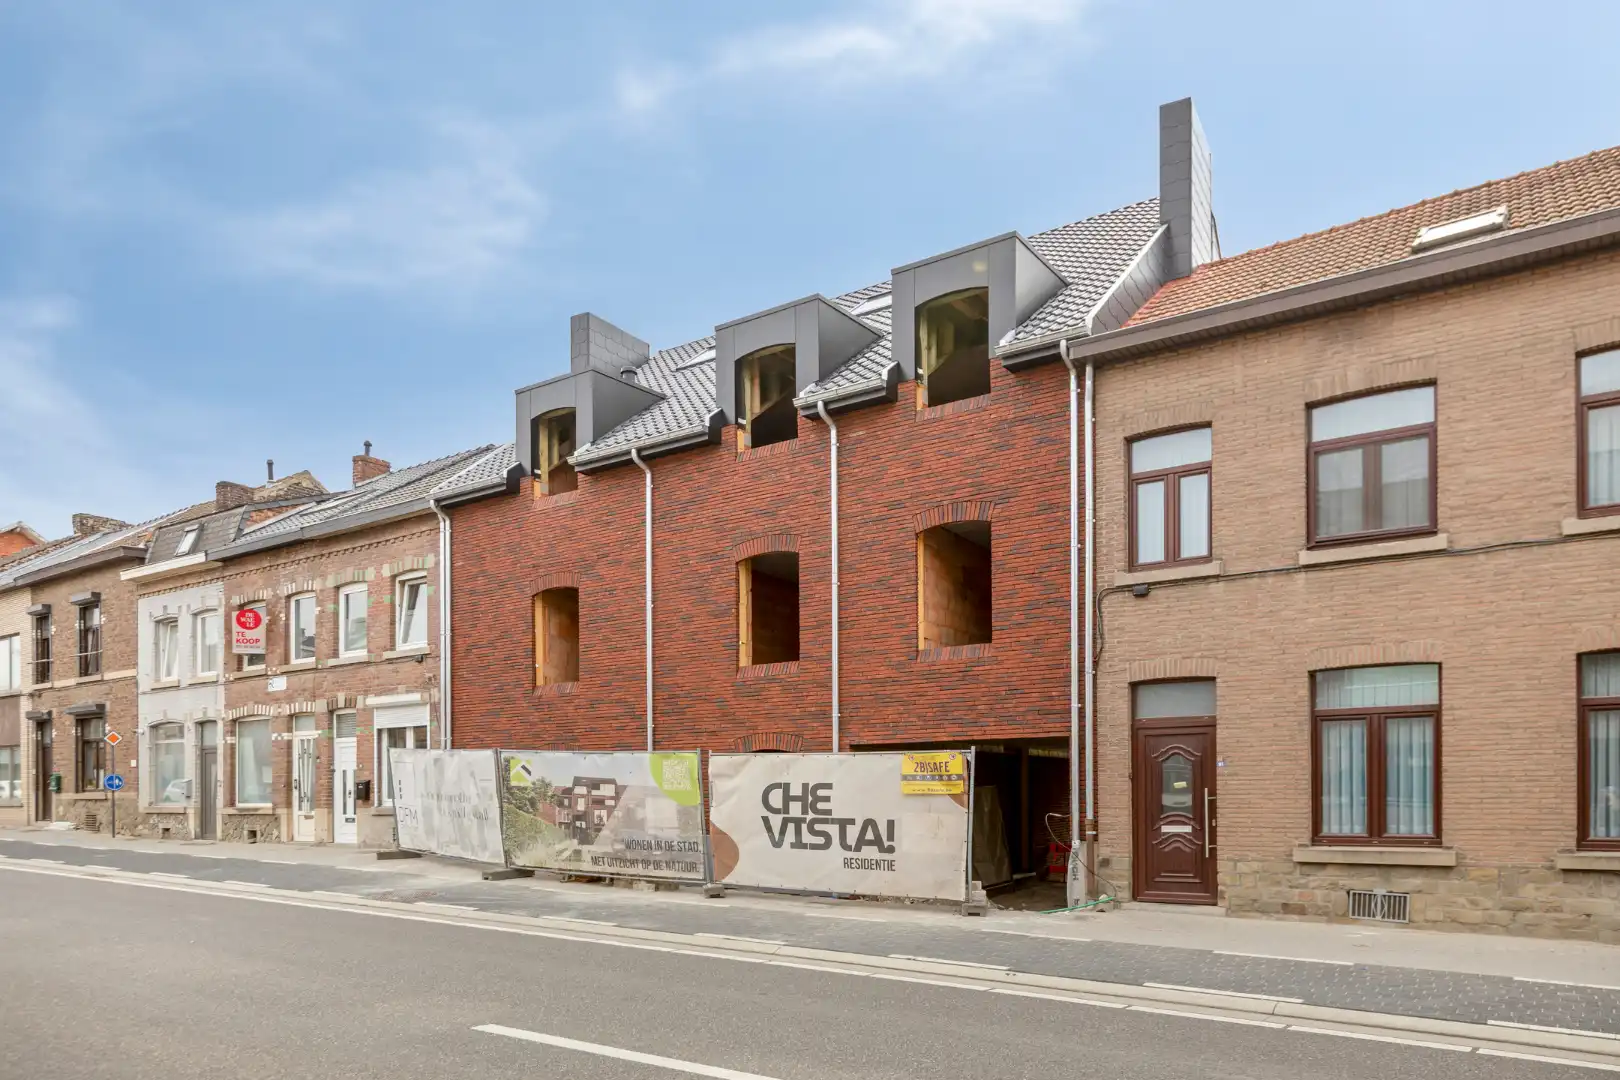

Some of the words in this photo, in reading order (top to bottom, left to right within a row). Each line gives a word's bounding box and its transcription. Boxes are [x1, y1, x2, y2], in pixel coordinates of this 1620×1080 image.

[761, 782, 833, 817] CHE
[761, 815, 896, 854] VISTA!
[624, 839, 653, 851] WONEN
[655, 840, 662, 851] IN
[665, 840, 676, 852] DE
[677, 841, 701, 853] STAD.
[591, 855, 605, 867] MET
[607, 857, 640, 869] UITZICHT
[642, 858, 652, 870] OP
[653, 860, 665, 871] DE
[666, 860, 700, 873] NATUUR.
[843, 857, 896, 872] RESIDENTIE
